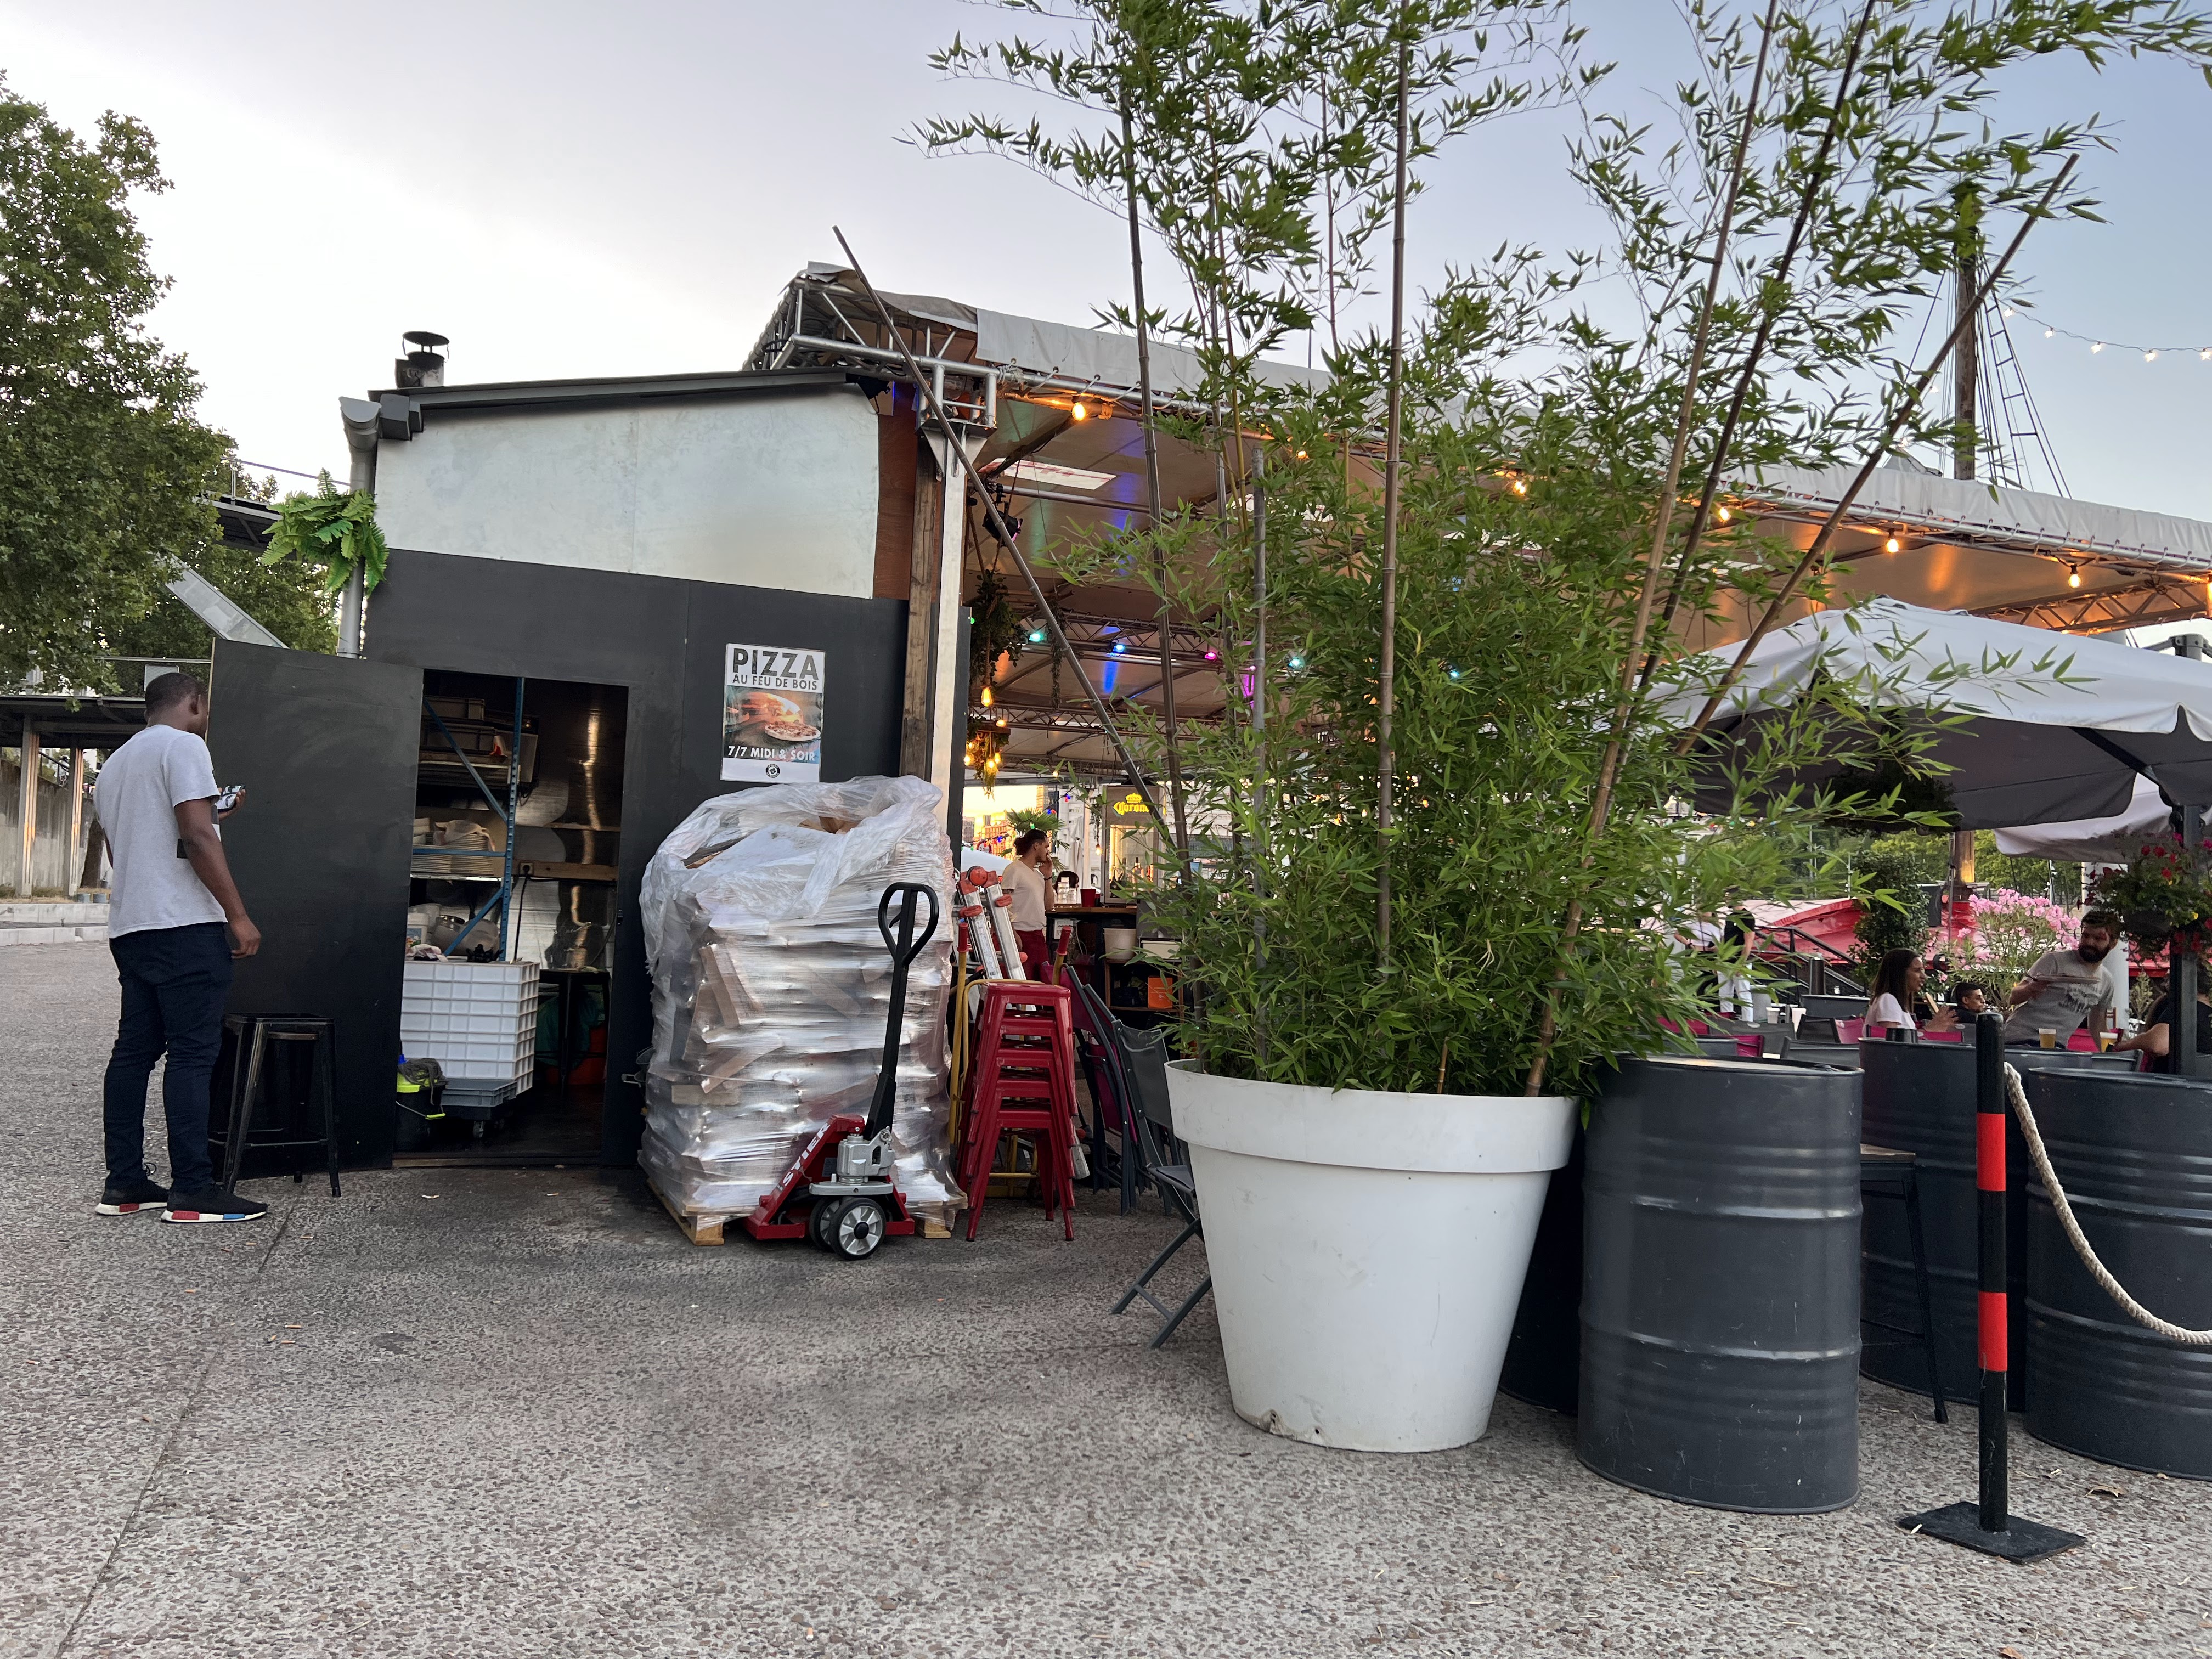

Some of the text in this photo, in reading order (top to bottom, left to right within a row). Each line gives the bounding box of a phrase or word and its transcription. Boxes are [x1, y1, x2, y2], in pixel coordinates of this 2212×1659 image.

[733, 648, 819, 680] PIZZA
[732, 674, 817, 690] AU FEU DE BOIS
[728, 746, 815, 761] 7/7 MIDI & SOIR
[782, 1122, 831, 1187] STIER
